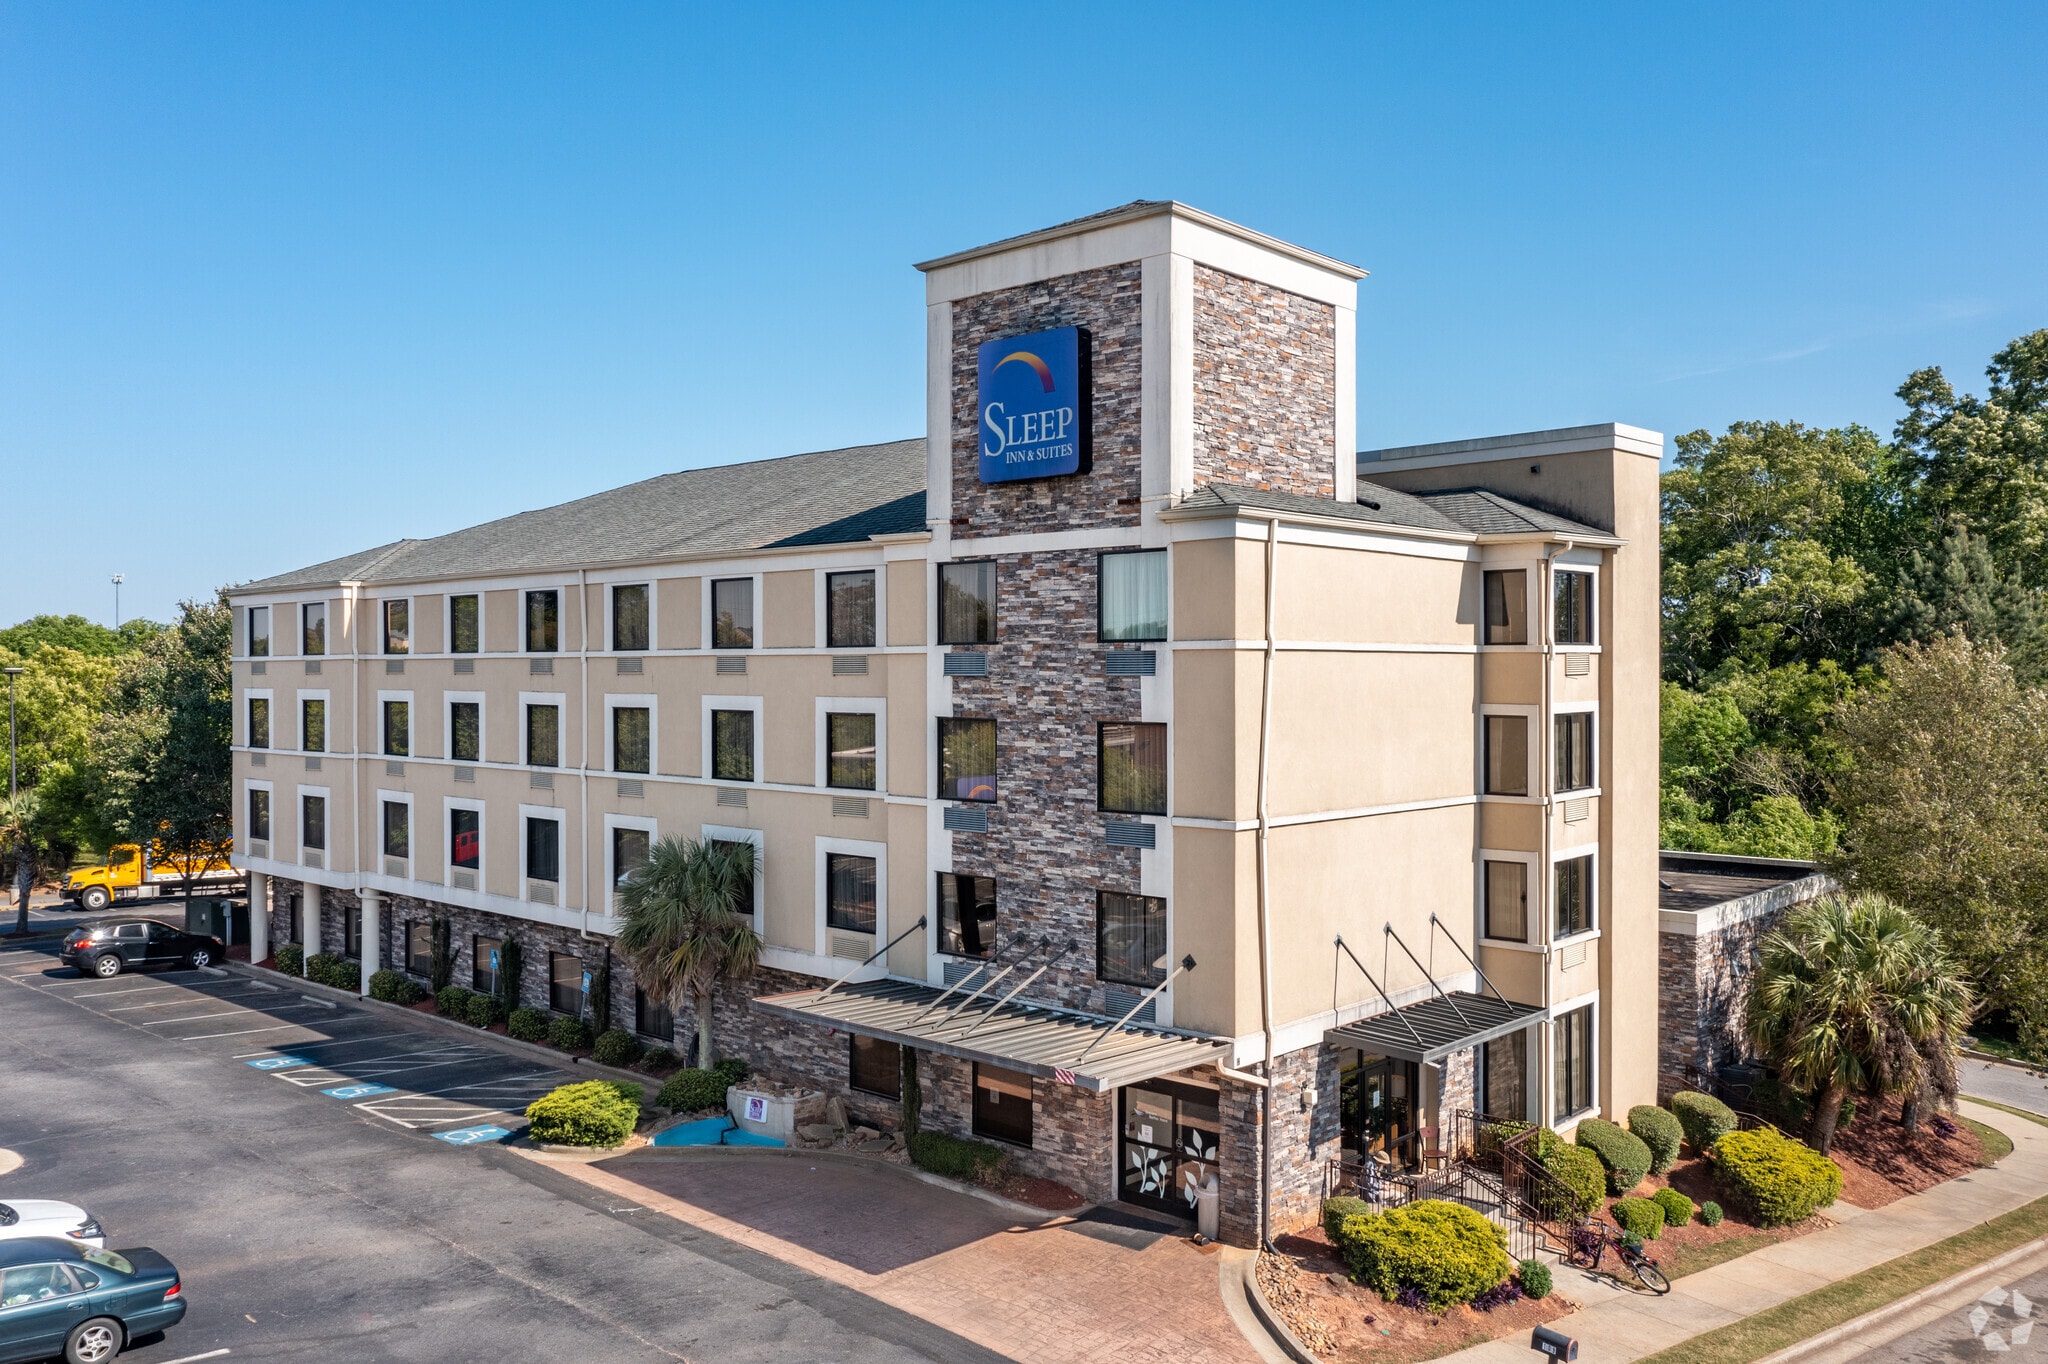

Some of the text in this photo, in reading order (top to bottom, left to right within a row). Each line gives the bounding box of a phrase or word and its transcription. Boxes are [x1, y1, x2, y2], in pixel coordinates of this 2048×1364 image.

[984, 402, 1073, 457] SLEEP
[1006, 443, 1073, 464] INN & SUITES
